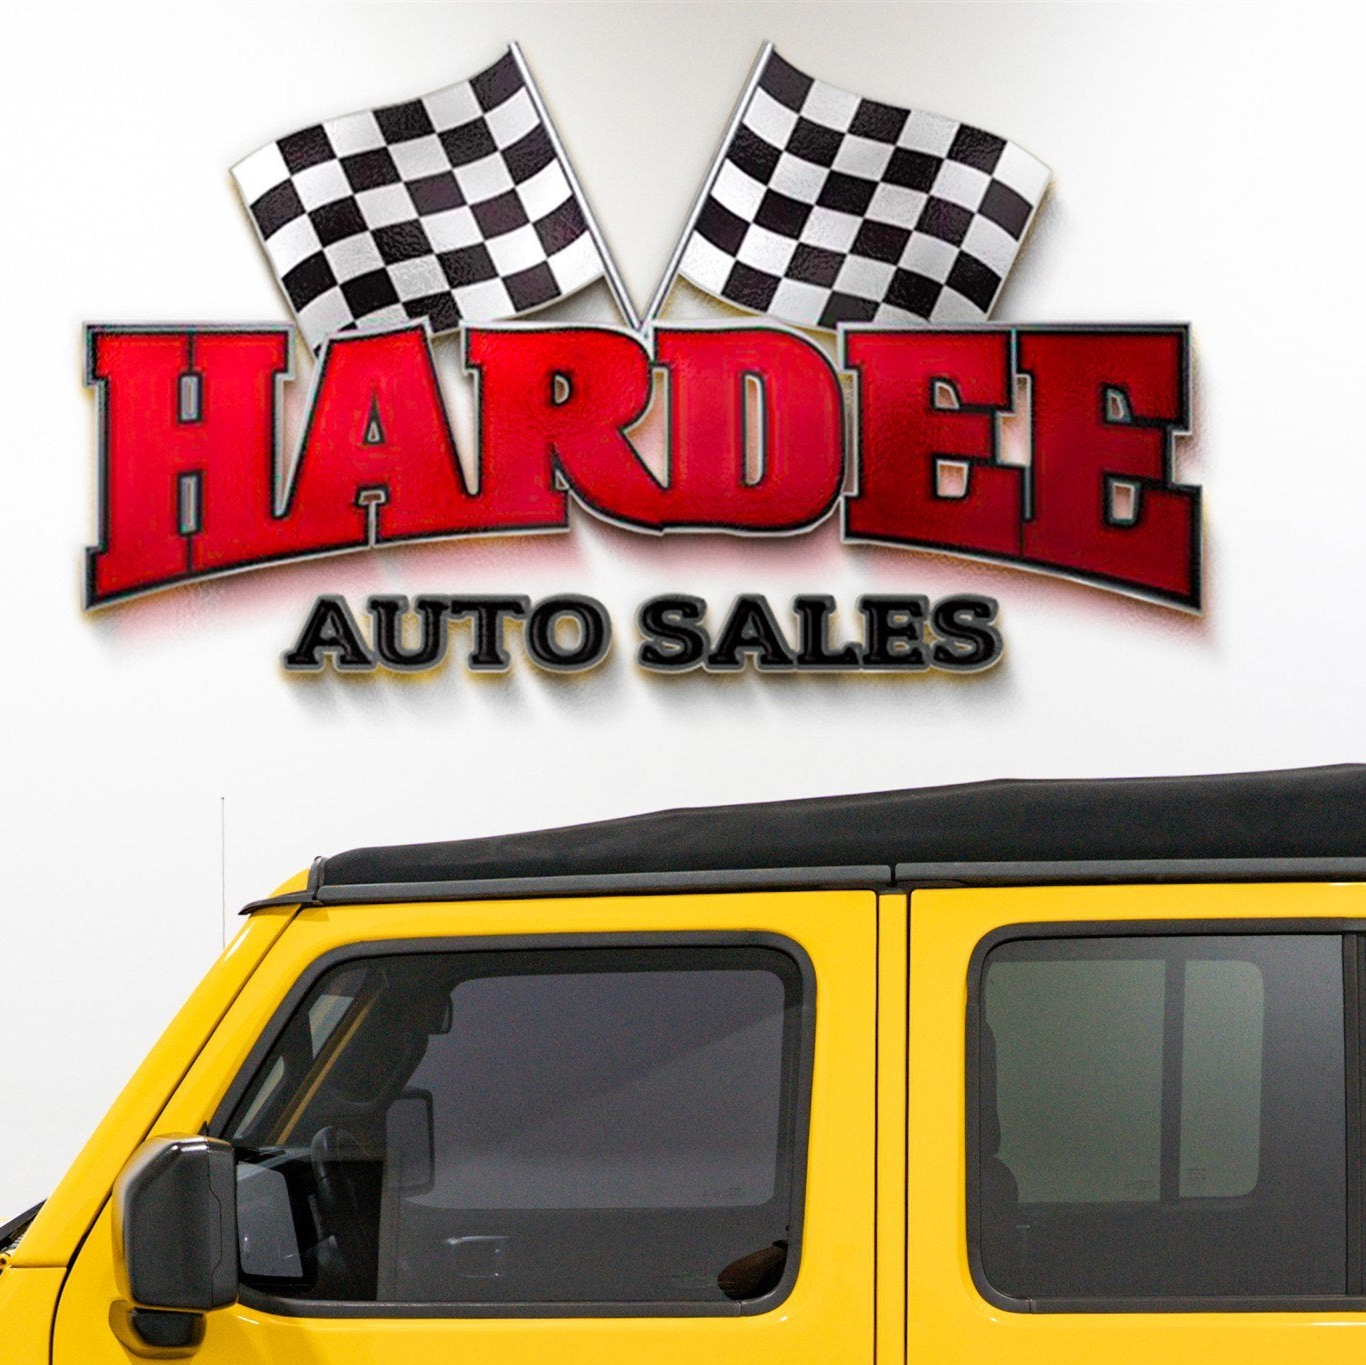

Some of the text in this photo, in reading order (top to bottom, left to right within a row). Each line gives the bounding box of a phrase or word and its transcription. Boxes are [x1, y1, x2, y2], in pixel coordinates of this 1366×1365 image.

[81, 320, 1204, 612] HARDEE
[283, 592, 1005, 673] AUTO SALES
